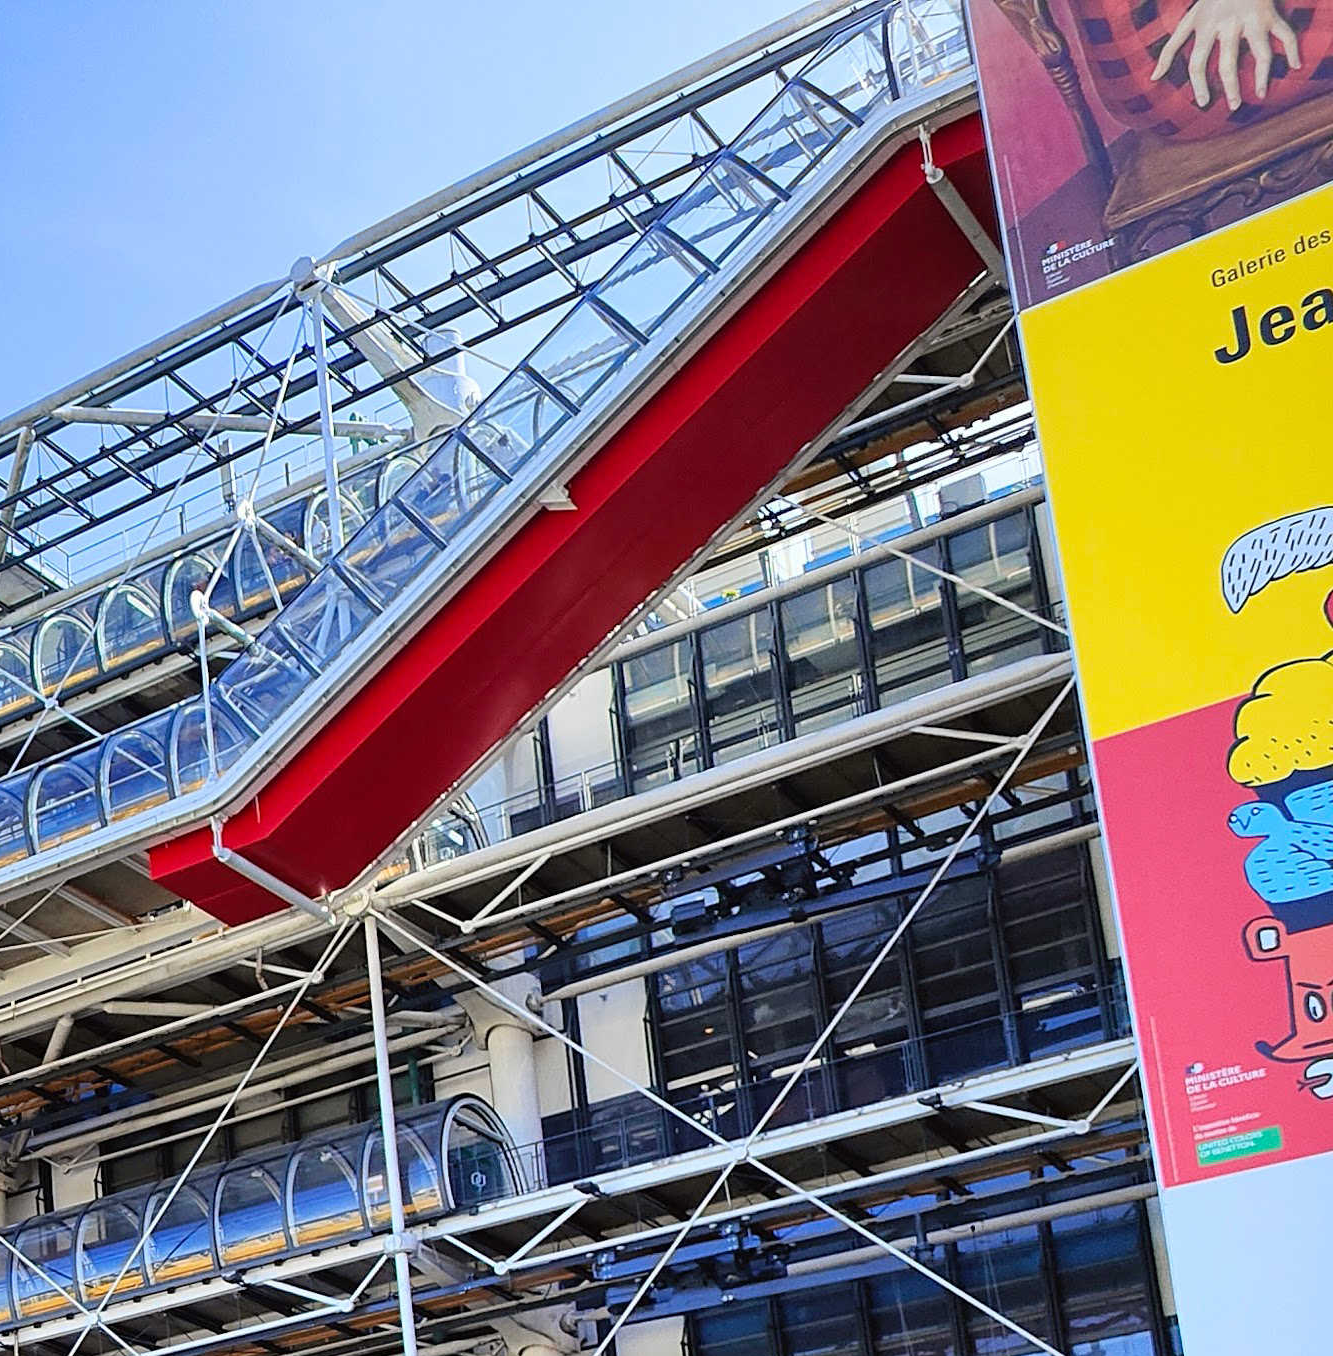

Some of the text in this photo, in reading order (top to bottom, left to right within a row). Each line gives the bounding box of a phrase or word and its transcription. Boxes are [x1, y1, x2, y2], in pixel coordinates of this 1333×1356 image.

[1041, 238, 1093, 267] MINISTÈRE
[1043, 238, 1116, 274] DE LA CULTURE
[1211, 228, 1333, 289] Galerie des
[1214, 287, 1333, 365] Jea
[1185, 1065, 1243, 1086] MINISTÈRE
[1186, 1067, 1268, 1095] DE LA CULTURE
